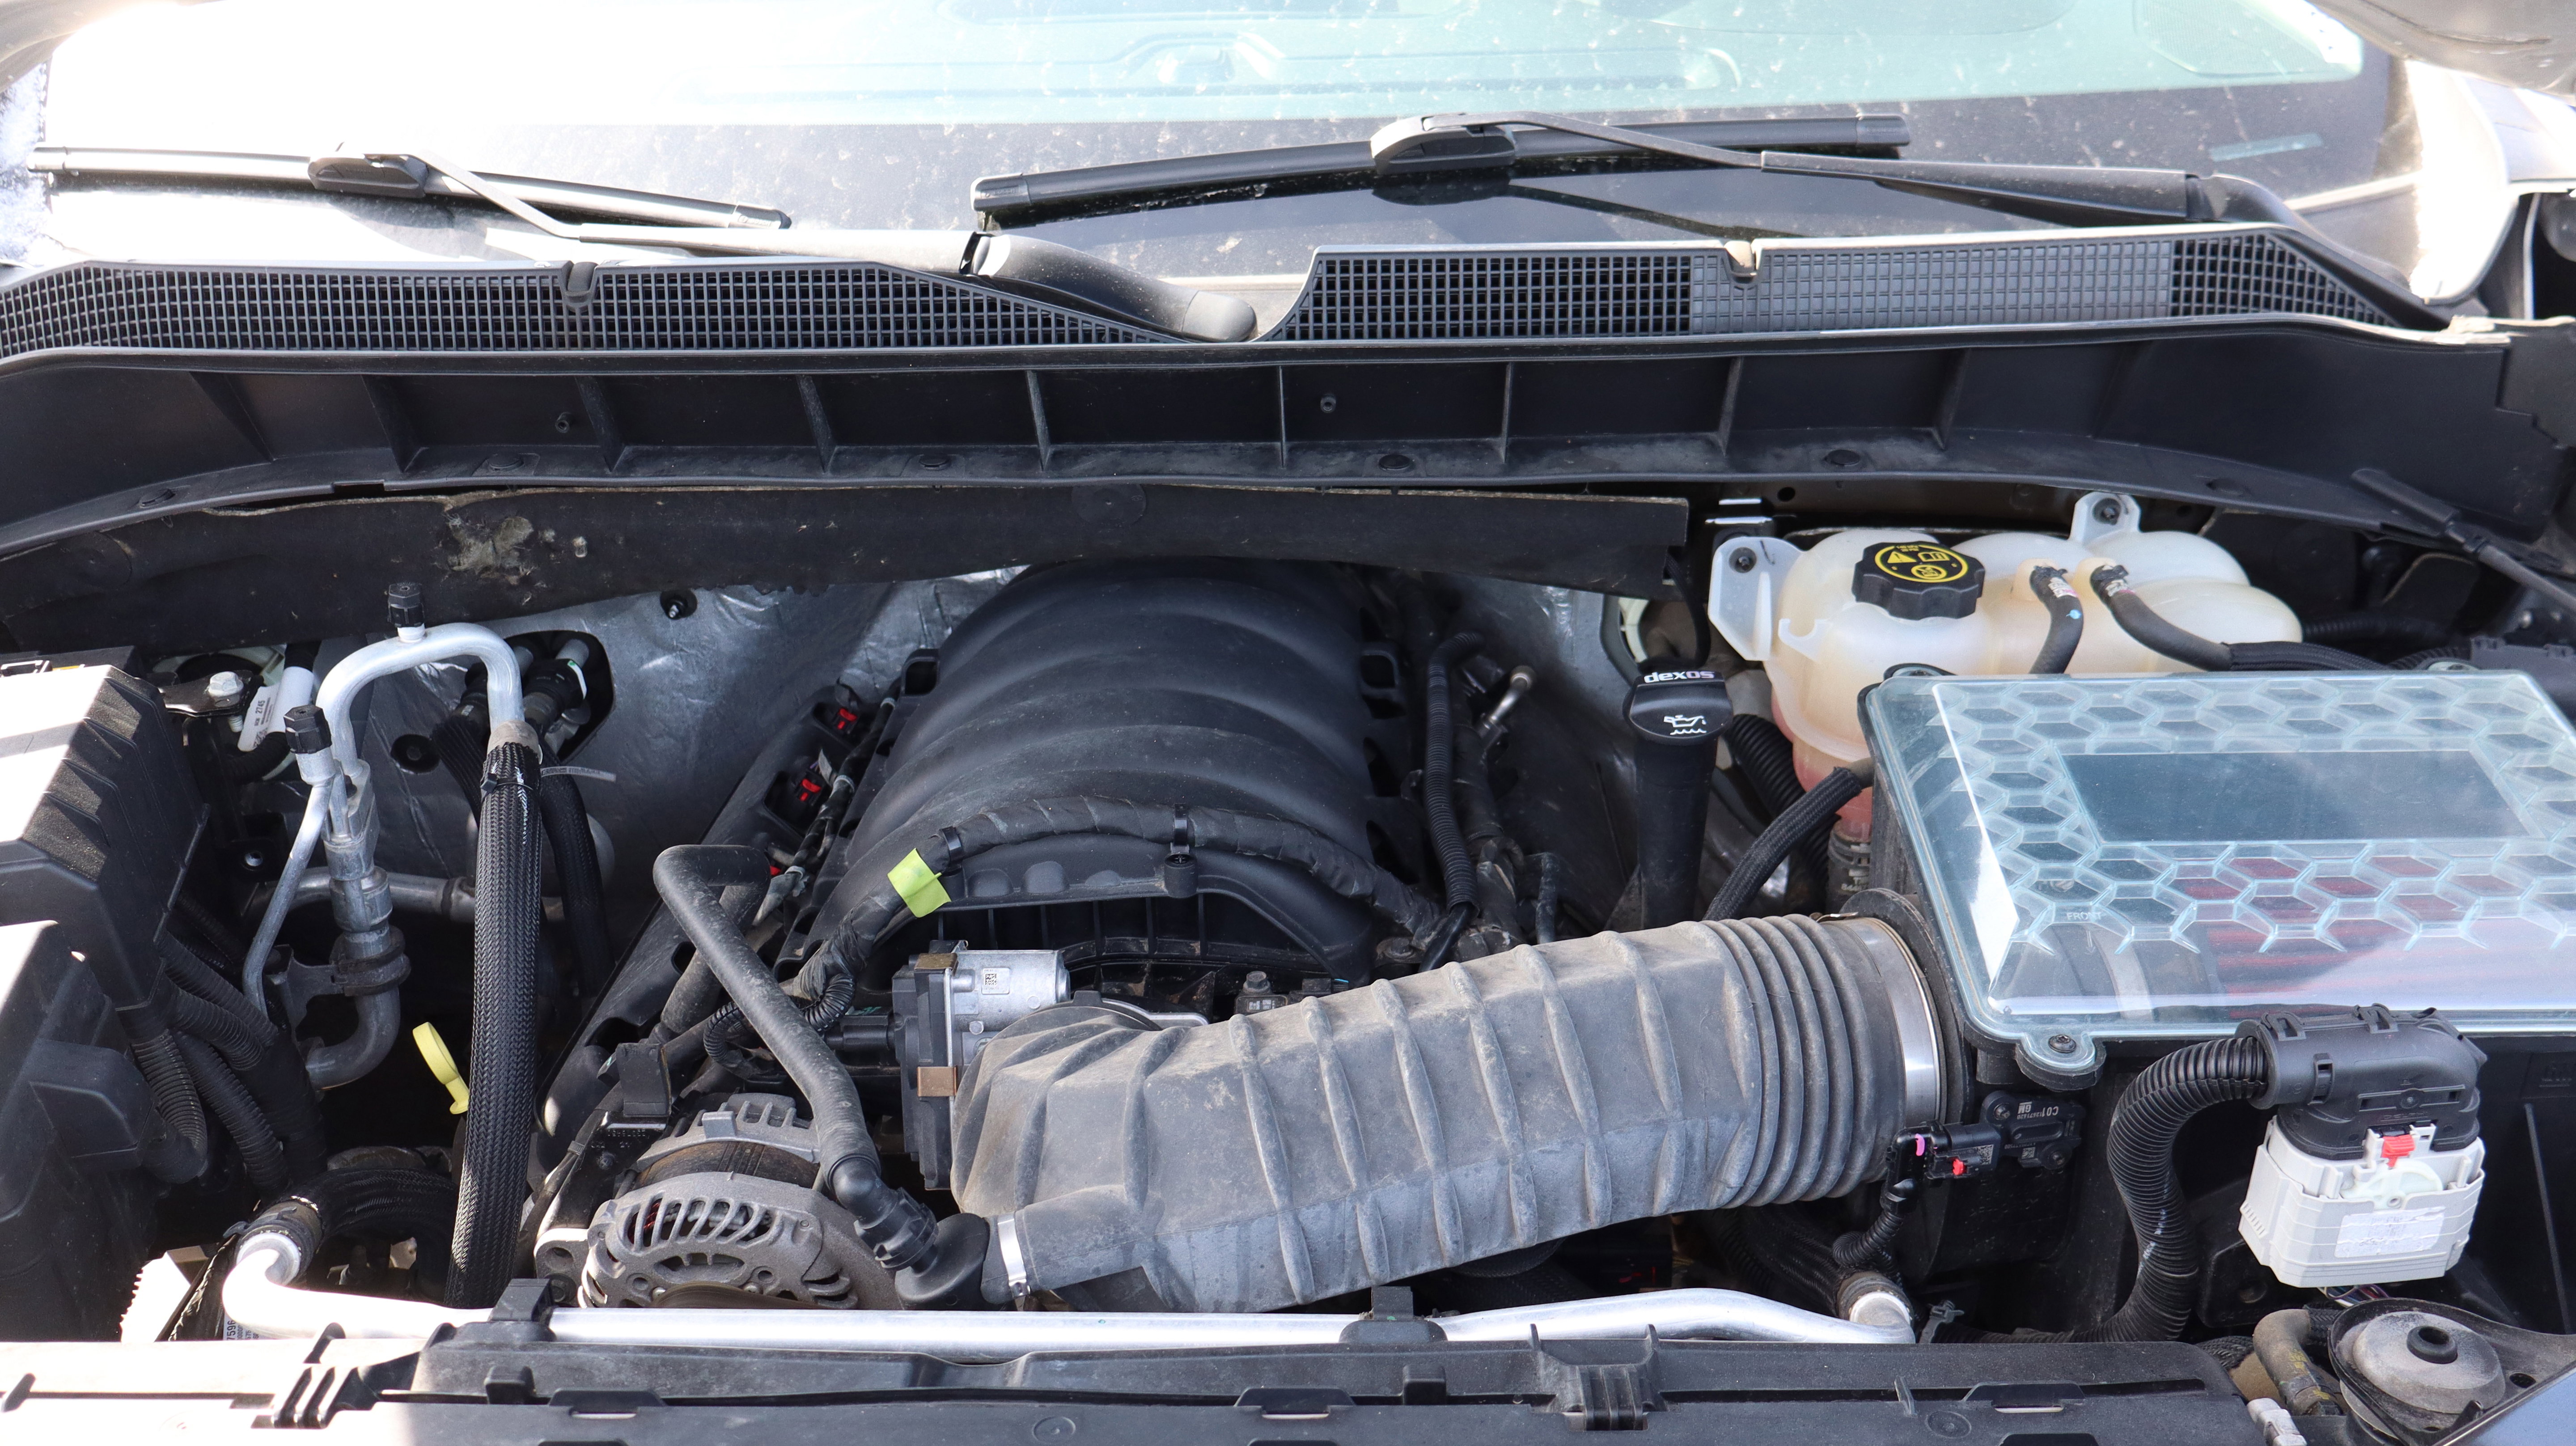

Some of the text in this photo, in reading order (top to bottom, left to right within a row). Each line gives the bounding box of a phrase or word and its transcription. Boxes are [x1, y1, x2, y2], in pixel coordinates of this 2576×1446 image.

[1644, 670, 1715, 683] dexos
[255, 700, 266, 714] 2745
[2066, 911, 2101, 920] FRONT
[2017, 1104, 2031, 1114] GM
